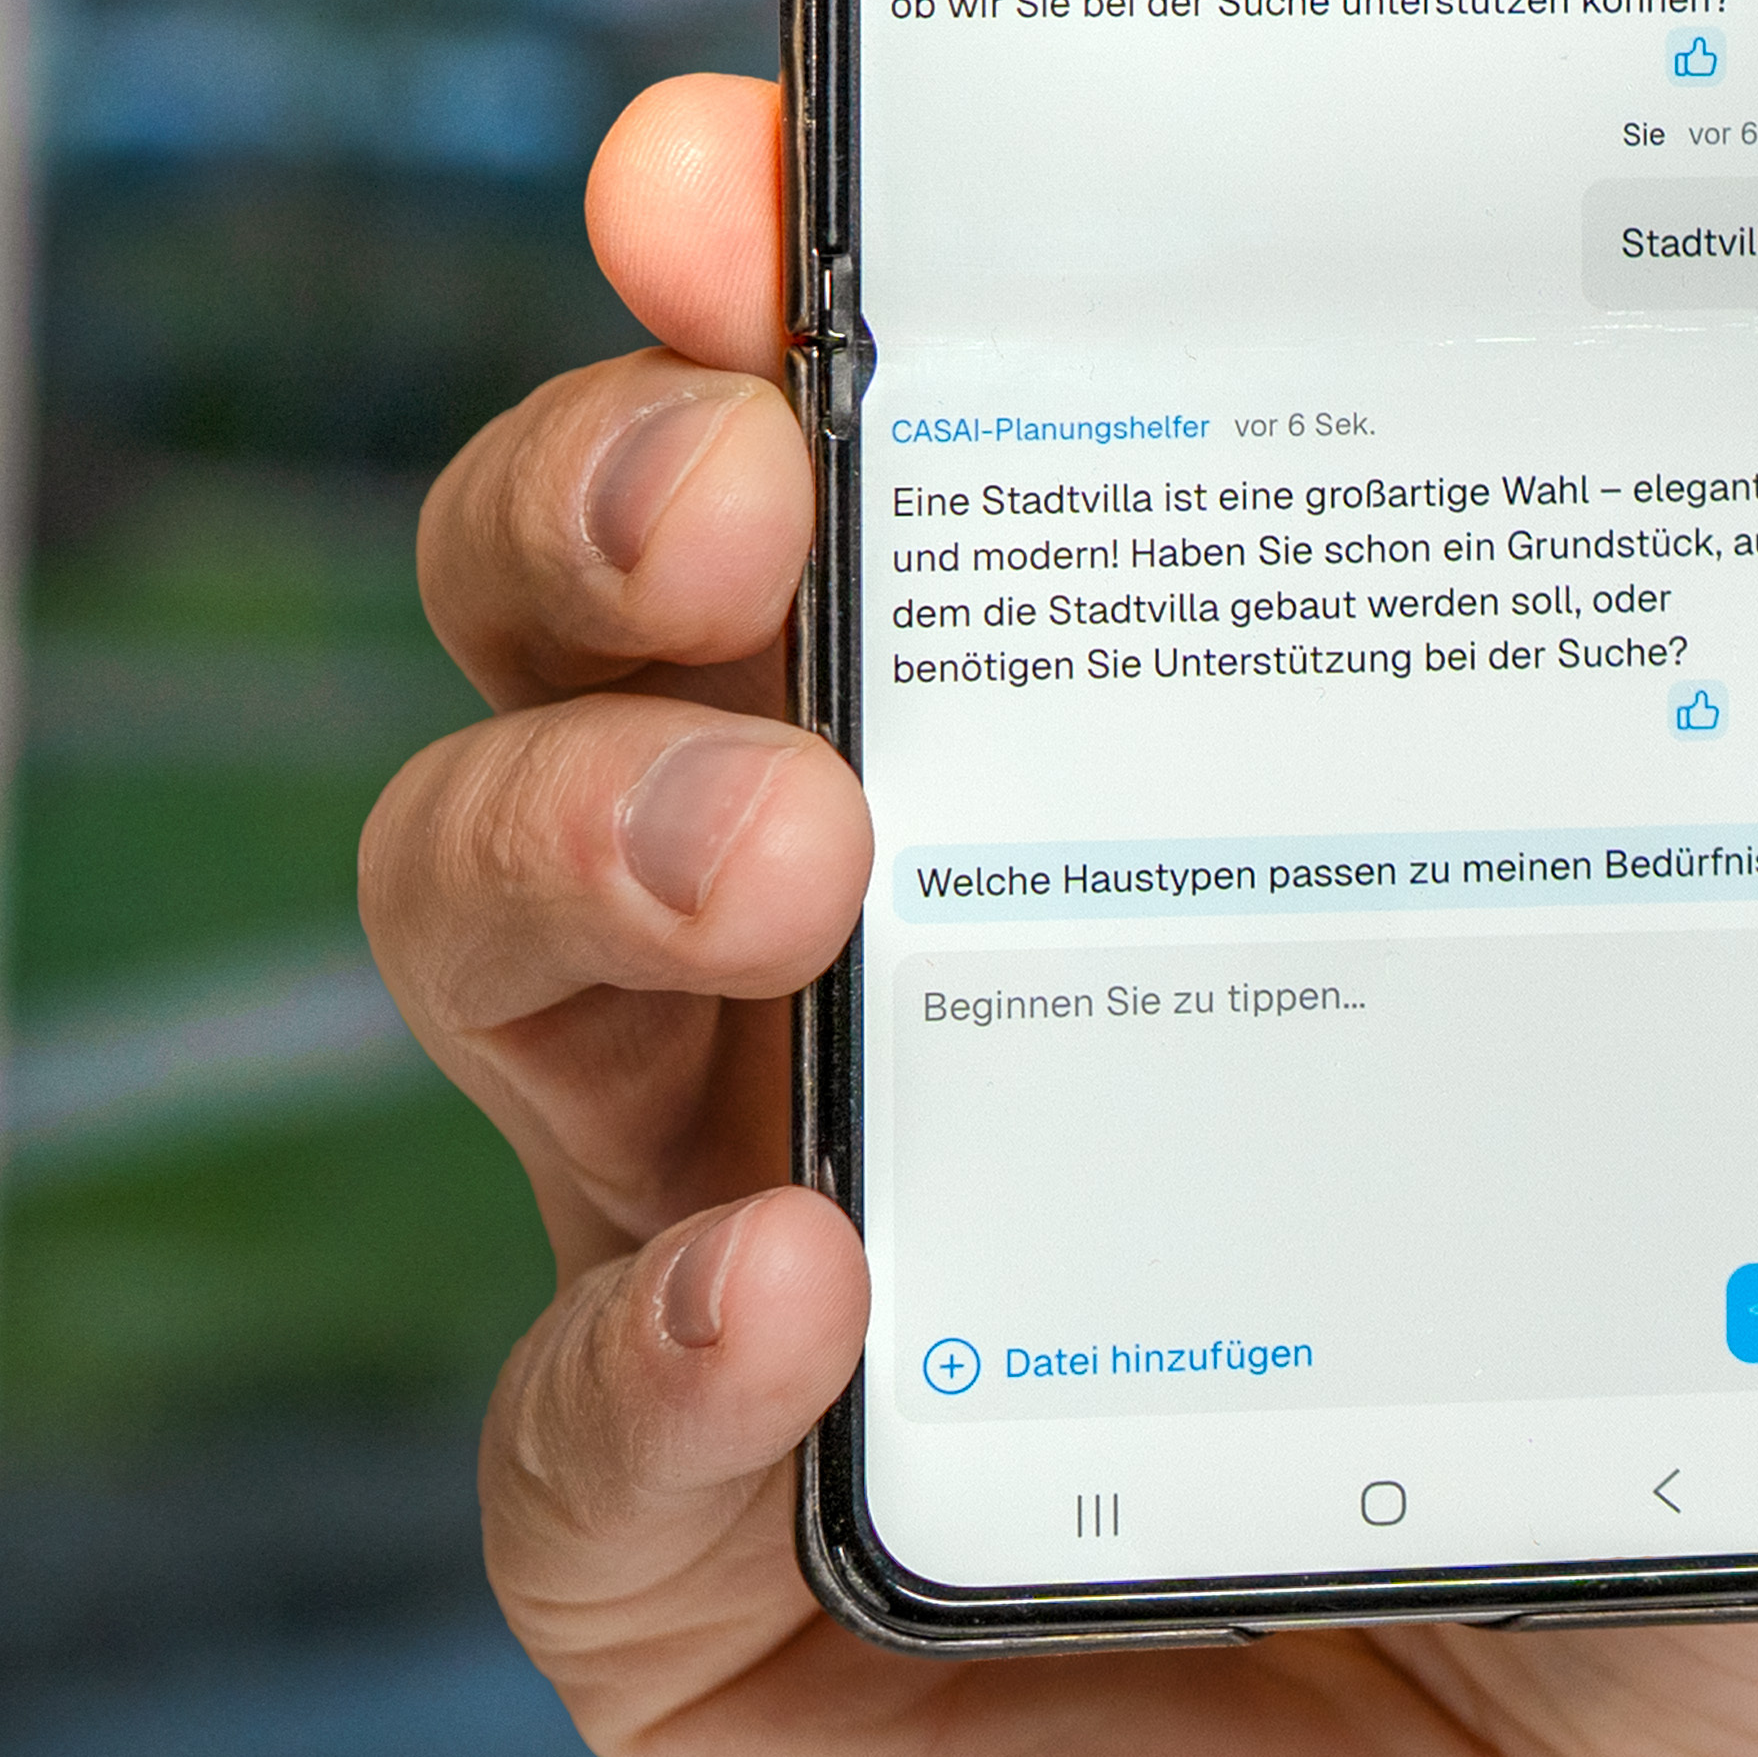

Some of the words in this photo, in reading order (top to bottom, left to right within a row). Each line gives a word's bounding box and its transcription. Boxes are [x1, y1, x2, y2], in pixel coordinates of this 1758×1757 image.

[1623, 121, 1666, 148] Sie
[1688, 126, 1732, 146] vor
[1741, 121, 1758, 146] 6
[891, 414, 1211, 446] CASAI-Planungshelfer
[1234, 418, 1278, 438] vor
[1288, 412, 1305, 437] 6
[1315, 412, 1375, 437] Sek.
[893, 486, 970, 518] Eine
[982, 482, 1154, 516] Stadtvilla
[1165, 482, 1208, 513] ist
[1218, 480, 1294, 512] eine
[1305, 477, 1491, 517] großartige
[1501, 474, 1590, 506] Wahl
[893, 541, 959, 574] und
[973, 538, 1119, 572] modern!
[1131, 537, 1246, 569] Haben
[1258, 534, 1313, 567] Sie
[1324, 533, 1431, 565] schon
[1443, 531, 1495, 563] ein
[1507, 526, 1723, 562] Grundstück,
[892, 598, 971, 629] dem
[983, 596, 1037, 628] die
[1049, 592, 1221, 626] Stadtvilla
[1230, 590, 1357, 629] gebaut
[1367, 587, 1499, 619] werden
[1511, 584, 1582, 620] soll,
[1592, 583, 1673, 615] oder
[893, 651, 1074, 688] benötigen
[1087, 648, 1142, 680] Sie
[1154, 644, 1412, 680] Unterstützung
[1425, 640, 1476, 673] bei
[1488, 639, 1547, 671] der
[1558, 635, 1688, 670] Suche?
[916, 865, 1051, 898] Welche
[1064, 863, 1256, 897] Haustypen
[1269, 862, 1397, 895] passen
[1409, 861, 1450, 885] zu
[1463, 851, 1592, 883] meinen
[924, 989, 1094, 1028] Beginnen
[1106, 985, 1162, 1017] Sie
[1173, 990, 1214, 1015] zu
[1227, 982, 1366, 1018] tippen...
[1006, 1345, 1098, 1379] Datei
[1111, 1339, 1313, 1376] hinzufügen
